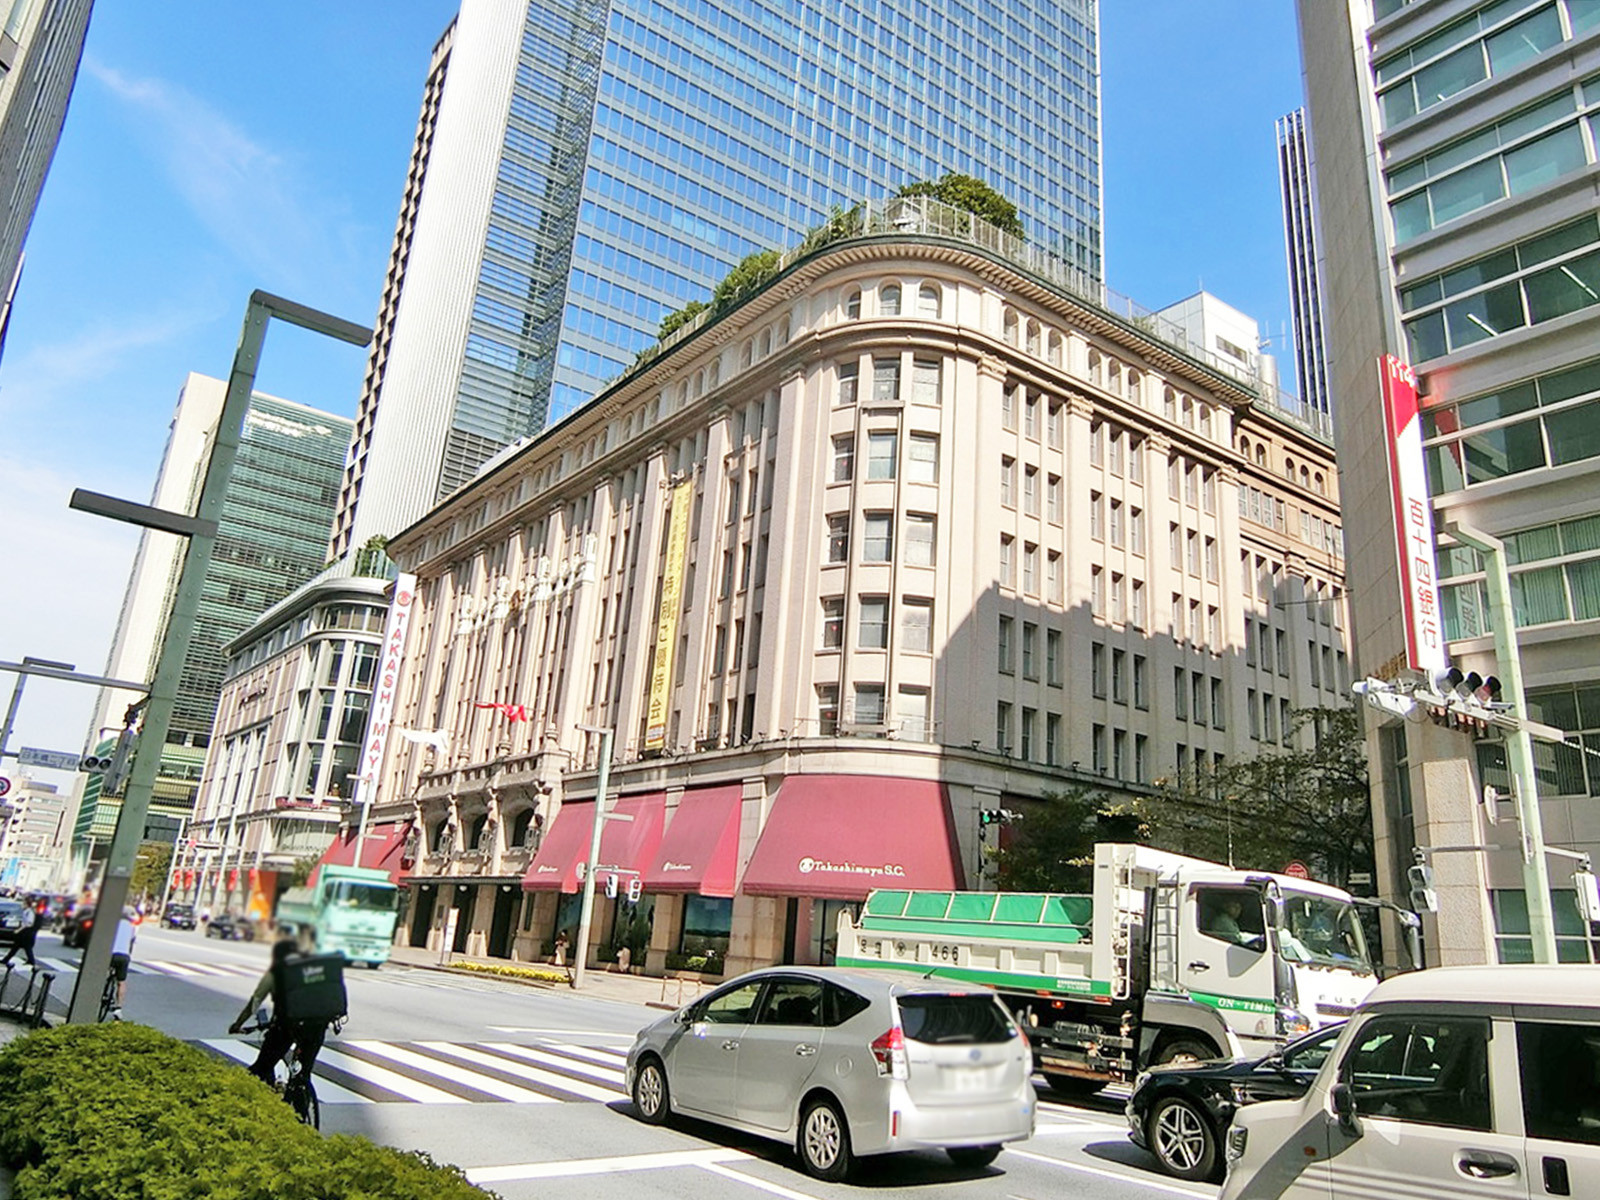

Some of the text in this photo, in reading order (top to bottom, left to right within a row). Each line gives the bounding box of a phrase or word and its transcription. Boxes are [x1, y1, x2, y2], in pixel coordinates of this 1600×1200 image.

[1408, 497, 1437, 650] 百十四銀行
[364, 612, 406, 785] TAKASHIMAYA
[815, 861, 883, 877] Takashimaya
